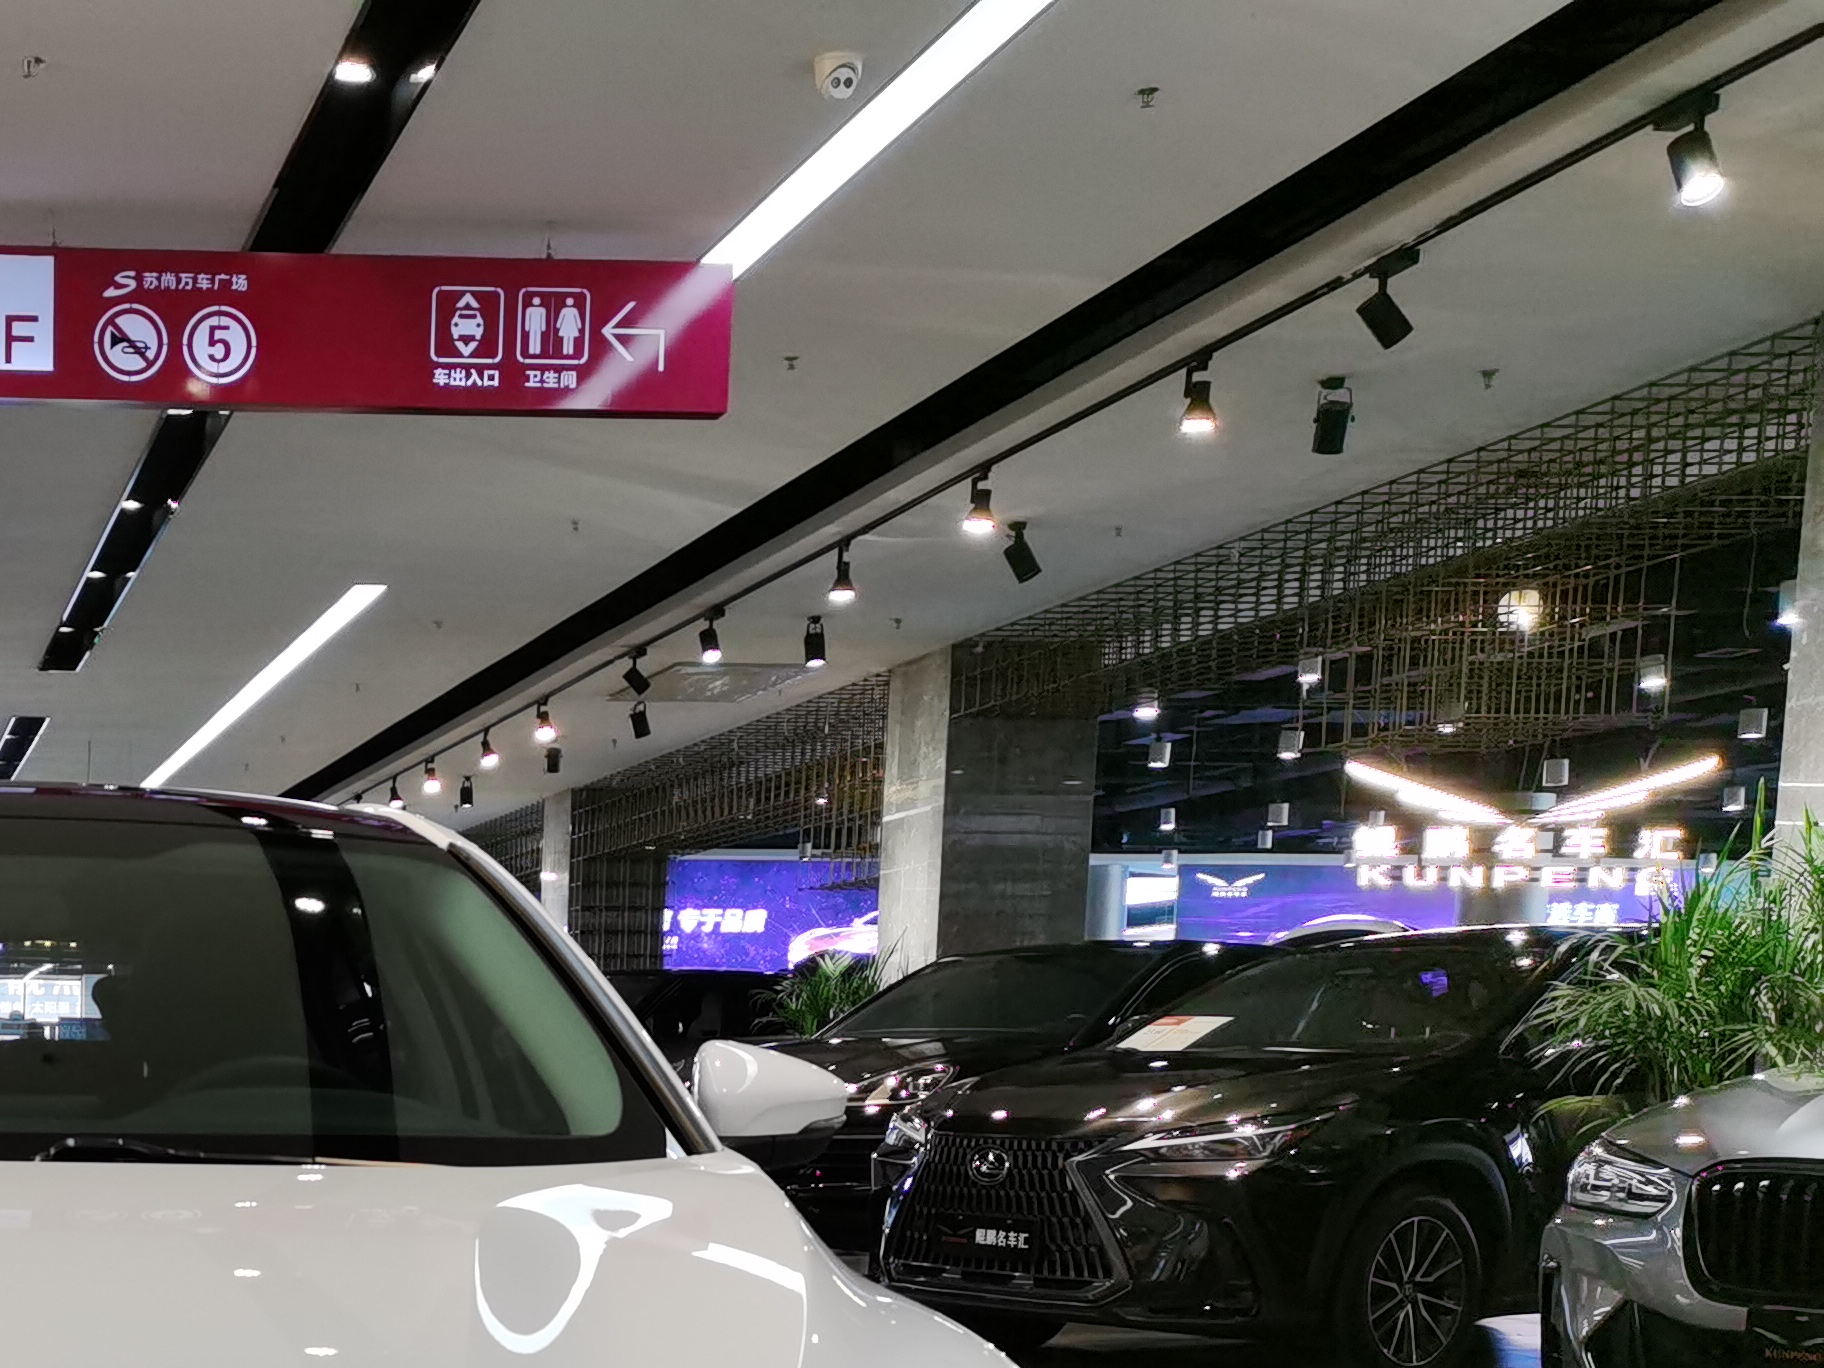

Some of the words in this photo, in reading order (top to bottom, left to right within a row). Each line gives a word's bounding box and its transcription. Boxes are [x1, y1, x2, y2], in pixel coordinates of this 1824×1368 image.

[142, 271, 249, 292] 苏尚万车广场
[207, 325, 231, 363] 5
[432, 368, 500, 388] 车出入口
[524, 369, 578, 389] 卫生间
